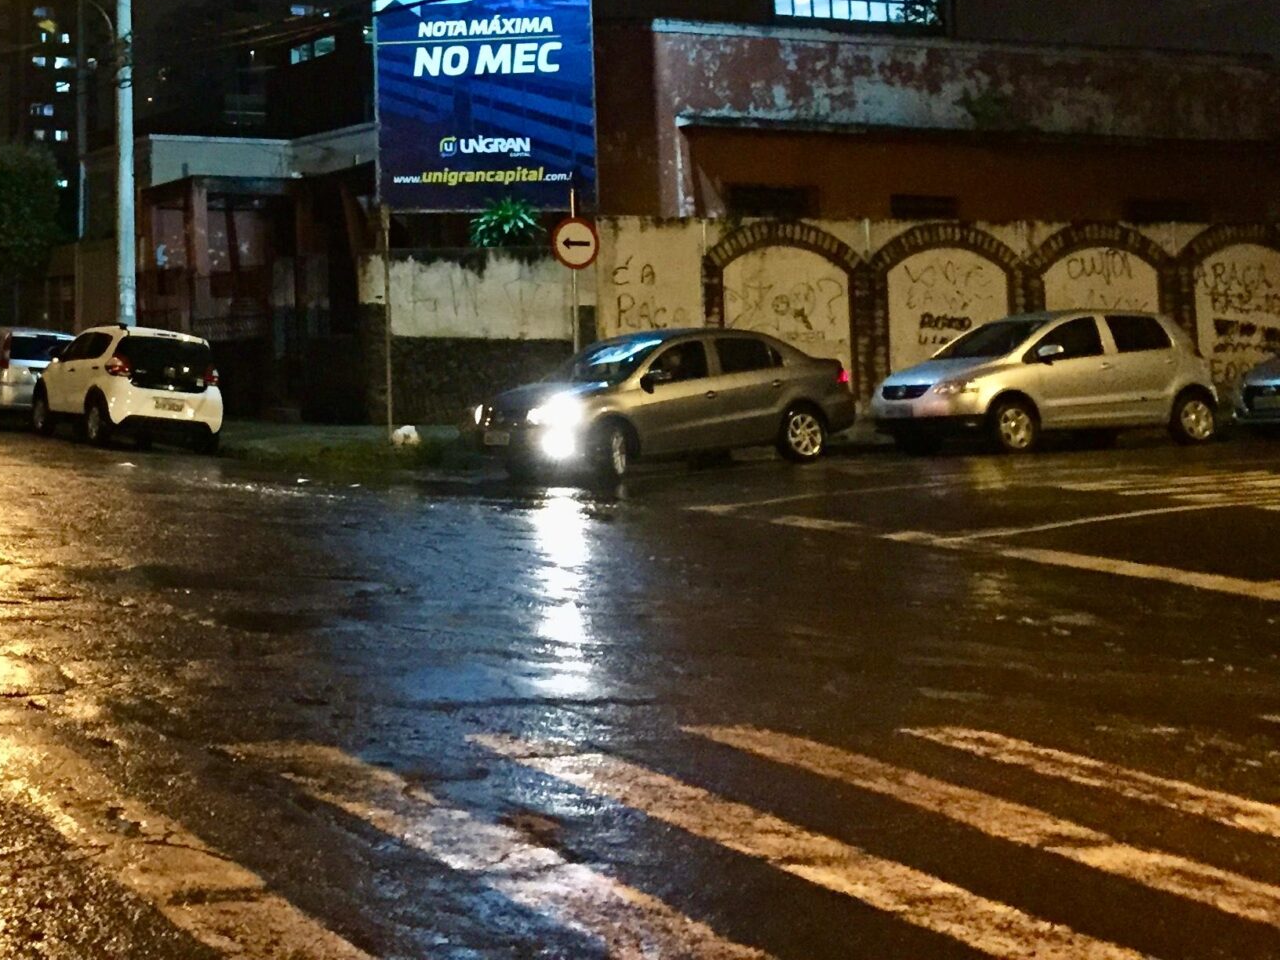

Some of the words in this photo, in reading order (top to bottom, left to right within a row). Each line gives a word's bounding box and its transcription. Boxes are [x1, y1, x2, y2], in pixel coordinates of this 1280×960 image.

[418, 20, 467, 38] NOTA
[469, 14, 554, 36] MÁXIMA
[413, 45, 470, 77] NO
[474, 41, 563, 75] MEC
